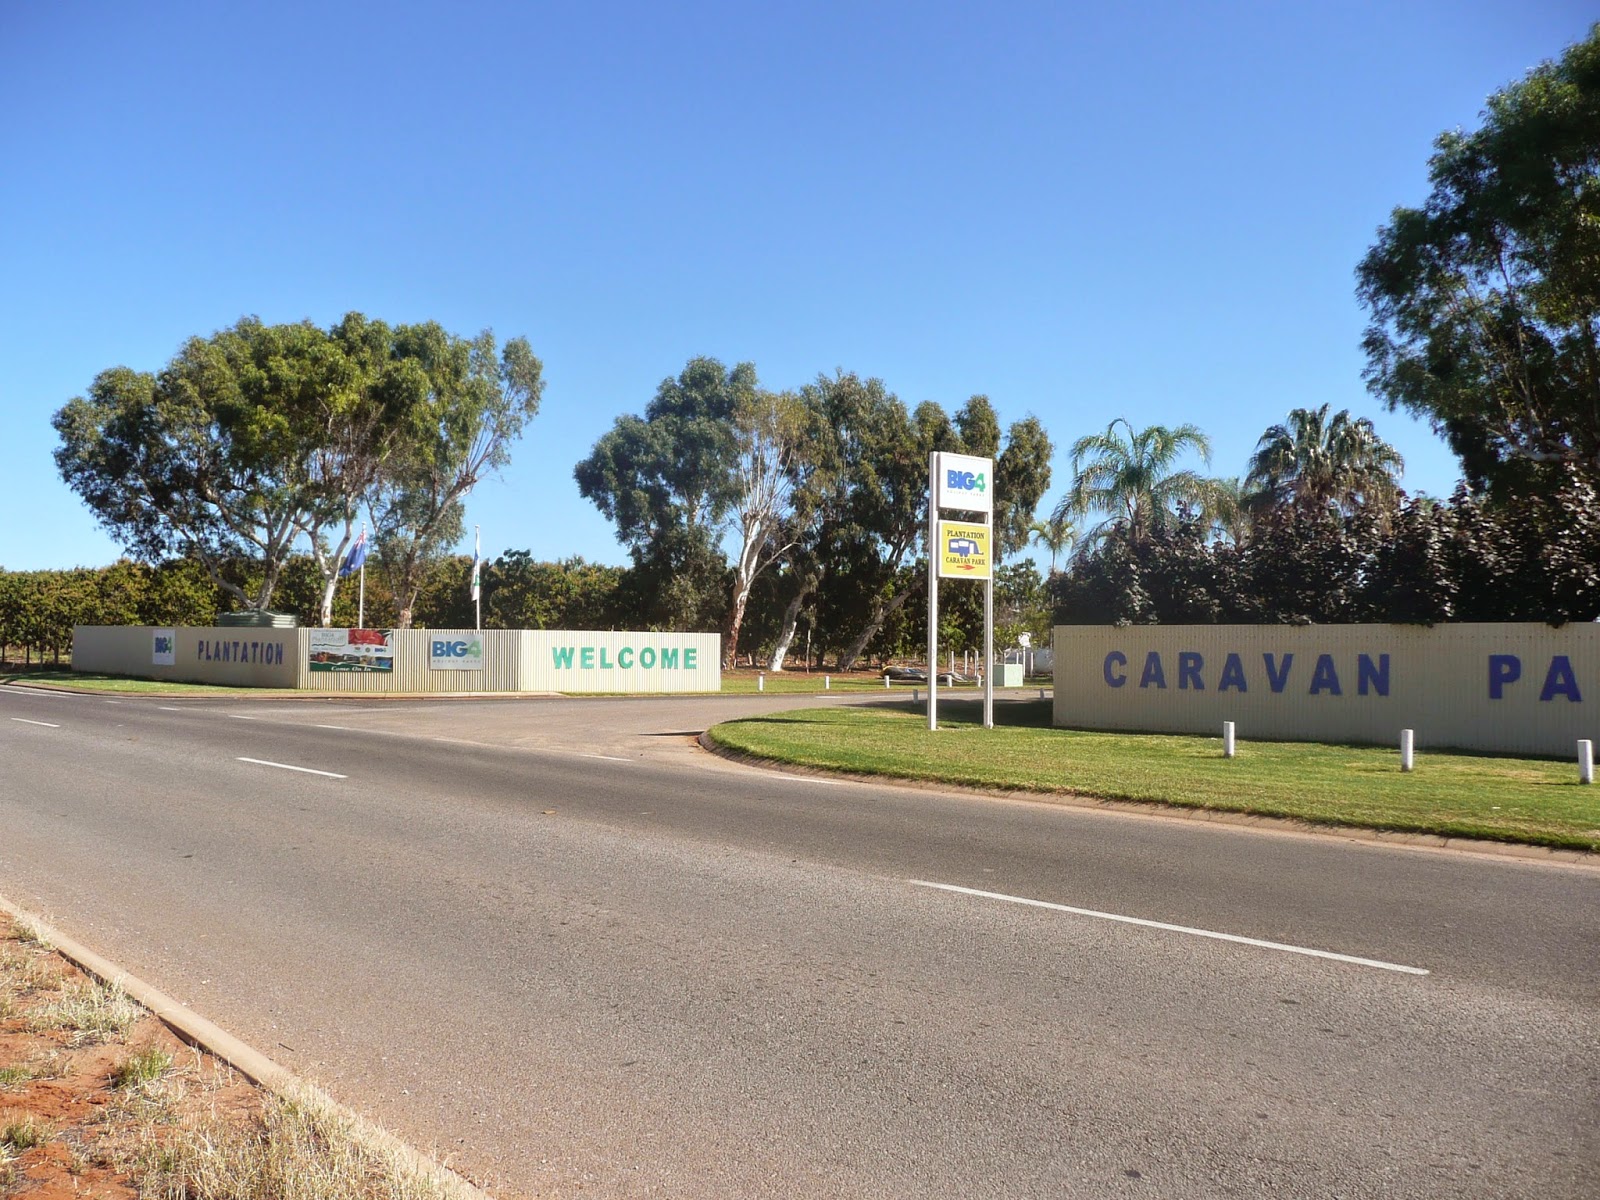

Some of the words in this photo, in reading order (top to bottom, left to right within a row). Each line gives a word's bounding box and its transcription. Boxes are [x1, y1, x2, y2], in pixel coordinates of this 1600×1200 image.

[947, 469, 986, 492] BIG4
[947, 529, 985, 539] PLANTATION
[945, 556, 970, 564] CARAVAN
[198, 640, 283, 665] PLANTATION
[432, 640, 481, 658] BIG4
[551, 646, 697, 669] WELCOME
[1103, 651, 1390, 696] CARAVAN
[1488, 654, 1583, 702] PA
